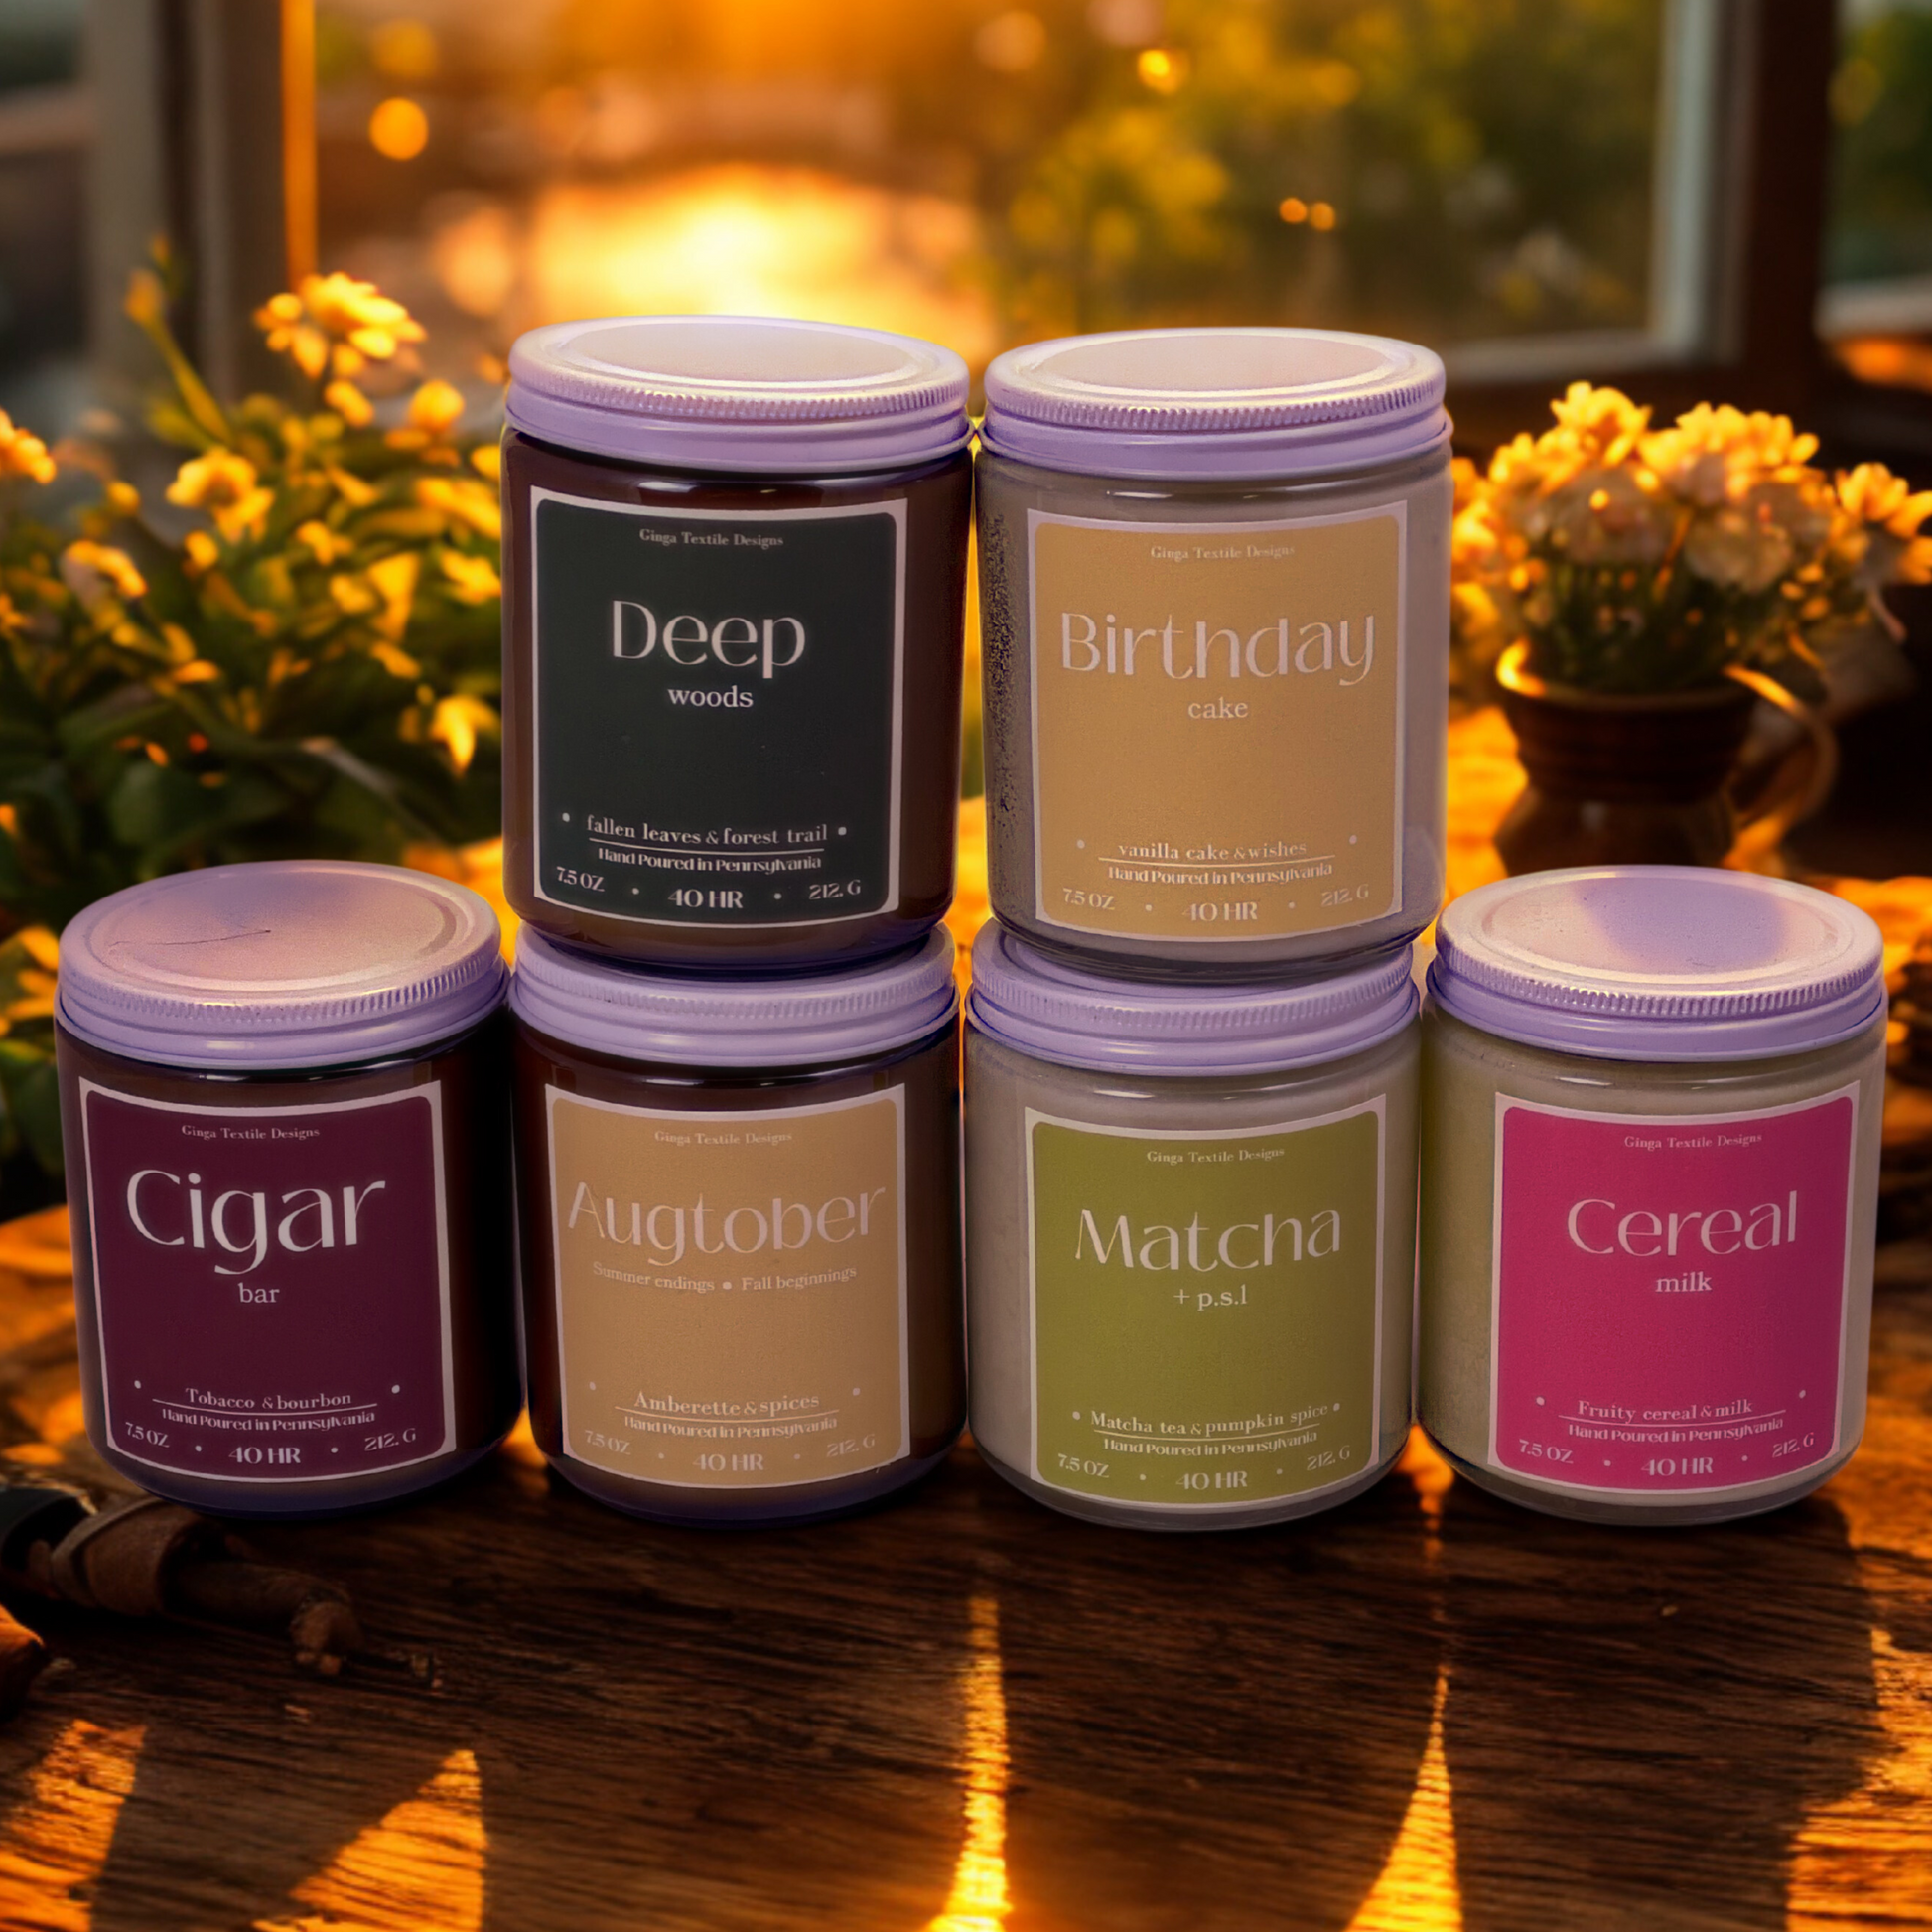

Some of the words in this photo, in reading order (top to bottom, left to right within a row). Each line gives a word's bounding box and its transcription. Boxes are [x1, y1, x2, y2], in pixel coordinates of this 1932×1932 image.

[639, 528, 677, 545] Ginga
[682, 532, 729, 546] Textile
[734, 534, 783, 550] Designs
[1150, 546, 1189, 562] Ginga
[1192, 546, 1242, 560] Textile
[1246, 543, 1296, 559] Designs
[612, 600, 805, 679] Deep
[1061, 612, 1374, 686] Birthday
[668, 685, 754, 708] woods
[1187, 697, 1248, 719] cake
[587, 815, 635, 838] fallen
[643, 823, 701, 844] leaves
[705, 831, 719, 844] &
[723, 827, 779, 845] forest
[787, 824, 827, 843] trail
[598, 848, 635, 865] Hand
[639, 854, 695, 870] Poured
[697, 858, 713, 870] in
[716, 856, 821, 875] Pennsylvania
[1119, 843, 1179, 860] vanilla
[1186, 844, 1229, 861] cake
[1233, 848, 1247, 860] &
[1247, 841, 1307, 858] wishes
[556, 866, 577, 885] 7.5
[580, 873, 605, 892] OZ
[667, 889, 703, 907] 40
[709, 891, 743, 908] HR
[809, 883, 843, 899] 212.
[847, 879, 861, 895] G
[1108, 866, 1149, 882] Hand
[1152, 870, 1209, 885] Poured
[1212, 871, 1228, 885] in
[1230, 863, 1332, 885] Pennsylvania
[1089, 893, 1115, 911] OZ
[1181, 902, 1218, 922] 40
[1223, 901, 1258, 921] HR
[1356, 884, 1369, 899] G
[181, 1125, 216, 1141] Ginga
[220, 1127, 267, 1140] Textile
[271, 1127, 320, 1141] Designs
[655, 1131, 691, 1147] Ginga
[695, 1133, 741, 1145] Textile
[745, 1132, 792, 1146] Designs
[1624, 1136, 1662, 1151] Ginga
[1666, 1137, 1713, 1149] Textile
[1717, 1133, 1762, 1148] Designs
[1147, 1150, 1183, 1166] Ginga
[1188, 1150, 1234, 1163] Textile
[1238, 1146, 1285, 1163] Designs
[127, 1169, 386, 1275] Cigar
[568, 1181, 886, 1267] Augtober
[1568, 1190, 1797, 1257] Cereal
[1074, 1209, 1340, 1272] Matcha
[593, 1261, 651, 1285] Summer
[655, 1276, 715, 1293] endings
[741, 1276, 772, 1291] Fall
[776, 1265, 857, 1290] beginnings
[1655, 1271, 1712, 1292] milk
[238, 1282, 280, 1304] bar
[1173, 1288, 1190, 1305] +
[1196, 1283, 1248, 1311] p.s.l
[185, 1388, 255, 1409] Tobacco
[262, 1397, 274, 1409] &
[276, 1394, 351, 1410] bourbon
[633, 1390, 741, 1416] Amberette
[743, 1402, 757, 1415] &
[760, 1396, 820, 1417] spices
[1578, 1400, 1636, 1424] Fruity
[1642, 1404, 1697, 1421] cereal
[1700, 1406, 1712, 1418] &
[1715, 1399, 1752, 1417] milk
[163, 1408, 197, 1425] Hand
[201, 1416, 252, 1431] Poured
[255, 1419, 270, 1431] in
[272, 1411, 375, 1431] Pennsylvania
[624, 1416, 661, 1432] Hand
[663, 1424, 717, 1438] Poured
[719, 1426, 734, 1438] in
[737, 1417, 838, 1438] Pennsylvania
[1090, 1410, 1152, 1432] Matcha
[1160, 1420, 1186, 1434] tea
[1190, 1423, 1201, 1435] &
[1205, 1414, 1284, 1437] pumpkin
[1290, 1404, 1328, 1426] spice
[1569, 1424, 1608, 1440] Hand
[1610, 1430, 1668, 1443] Poured
[1671, 1430, 1686, 1442] in
[1688, 1418, 1783, 1441] Pennsylvania
[147, 1430, 170, 1448] OZ
[228, 1447, 262, 1464] 40
[268, 1448, 301, 1464] HR
[364, 1433, 399, 1451] 212.
[402, 1428, 416, 1443] G
[608, 1438, 631, 1455] OZ
[693, 1453, 725, 1471] 40
[731, 1454, 764, 1471] HR
[863, 1434, 876, 1448] G
[1104, 1438, 1143, 1453] Hand
[1146, 1444, 1202, 1456] Poured
[1204, 1444, 1219, 1455] in
[1221, 1430, 1317, 1455] Pennsylvania
[1519, 1439, 1543, 1456] 7.5
[1547, 1446, 1574, 1464] OZ
[1640, 1459, 1676, 1476] 40
[1681, 1457, 1714, 1474] HR
[1772, 1440, 1801, 1457] 212.
[1803, 1432, 1815, 1448] G
[1058, 1453, 1080, 1471] 7.5
[1083, 1459, 1110, 1478] OZ
[1175, 1472, 1210, 1489] 40
[1215, 1471, 1247, 1488] HR
[1339, 1446, 1350, 1459] G
